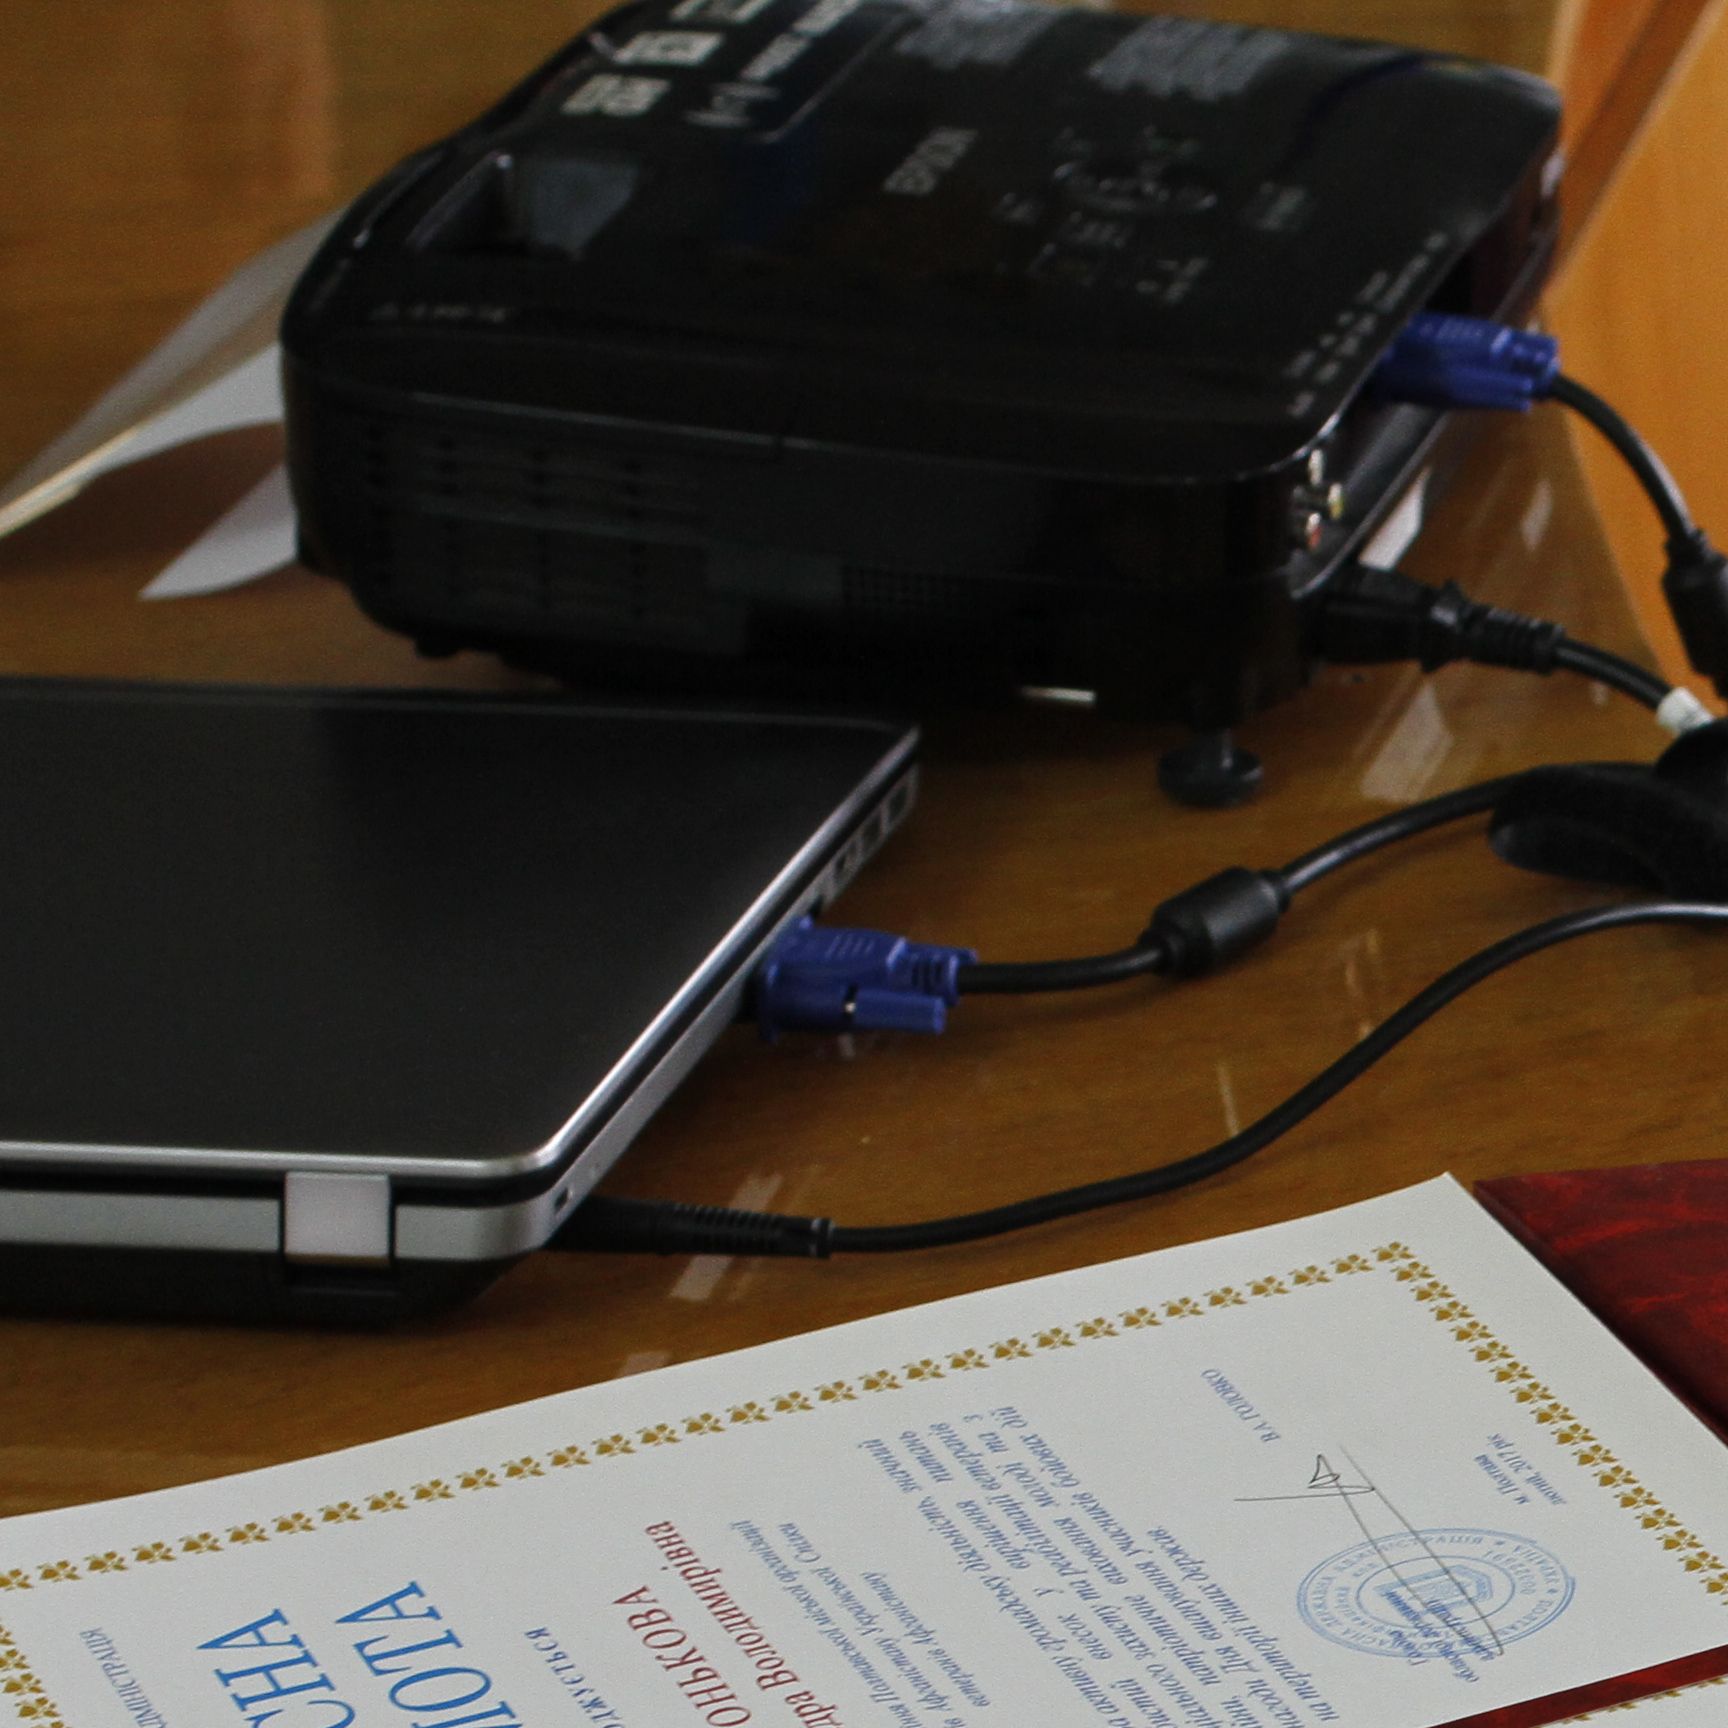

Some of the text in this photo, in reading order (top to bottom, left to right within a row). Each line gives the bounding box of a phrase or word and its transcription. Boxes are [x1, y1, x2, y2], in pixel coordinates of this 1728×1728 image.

[990, 1406, 1029, 1429] дій
[1200, 1368, 1261, 1421] ГОЛОВКО
[856, 1438, 923, 1494] значний
[898, 1430, 954, 1483] питань
[927, 1422, 1002, 1491] ветеранів
[977, 1431, 1010, 1454] та
[1018, 1433, 1081, 1488] бойових
[1486, 1433, 1516, 1450] рік
[1496, 1450, 1534, 1474] 2017
[997, 1461, 1061, 1508] молоді
[1473, 1453, 1520, 1496] Полтава
[728, 1519, 801, 1584] організації
[777, 1522, 822, 1564] Спілки
[955, 1499, 1032, 1570] вирішення
[985, 1493, 1089, 1578] реабілітації
[1052, 1516, 1129, 1585] виховання
[1070, 1492, 1154, 1558] учасників
[644, 1520, 801, 1691] Володимирівна
[781, 1584, 837, 1627] міської
[808, 1566, 885, 1637] Української
[979, 1575, 1067, 1652] громадську
[1068, 1579, 1102, 1602] та
[1134, 1560, 1223, 1641] вшанування
[1197, 1582, 1250, 1625] інших
[859, 1571, 991, 1708] ветеранів Афганістану
[1056, 1612, 1114, 1661] внесок
[1089, 1604, 1157, 1661] захисту
[1123, 1594, 1222, 1686] патріотичне
[1204, 1645, 1261, 1675] Дня
[817, 1627, 901, 1704] Полтавської
[873, 1637, 954, 1712] Афганістану
[1050, 1655, 1121, 1715] активну
[1231, 1625, 1321, 1701] території
[1308, 1701, 1341, 1722] на
